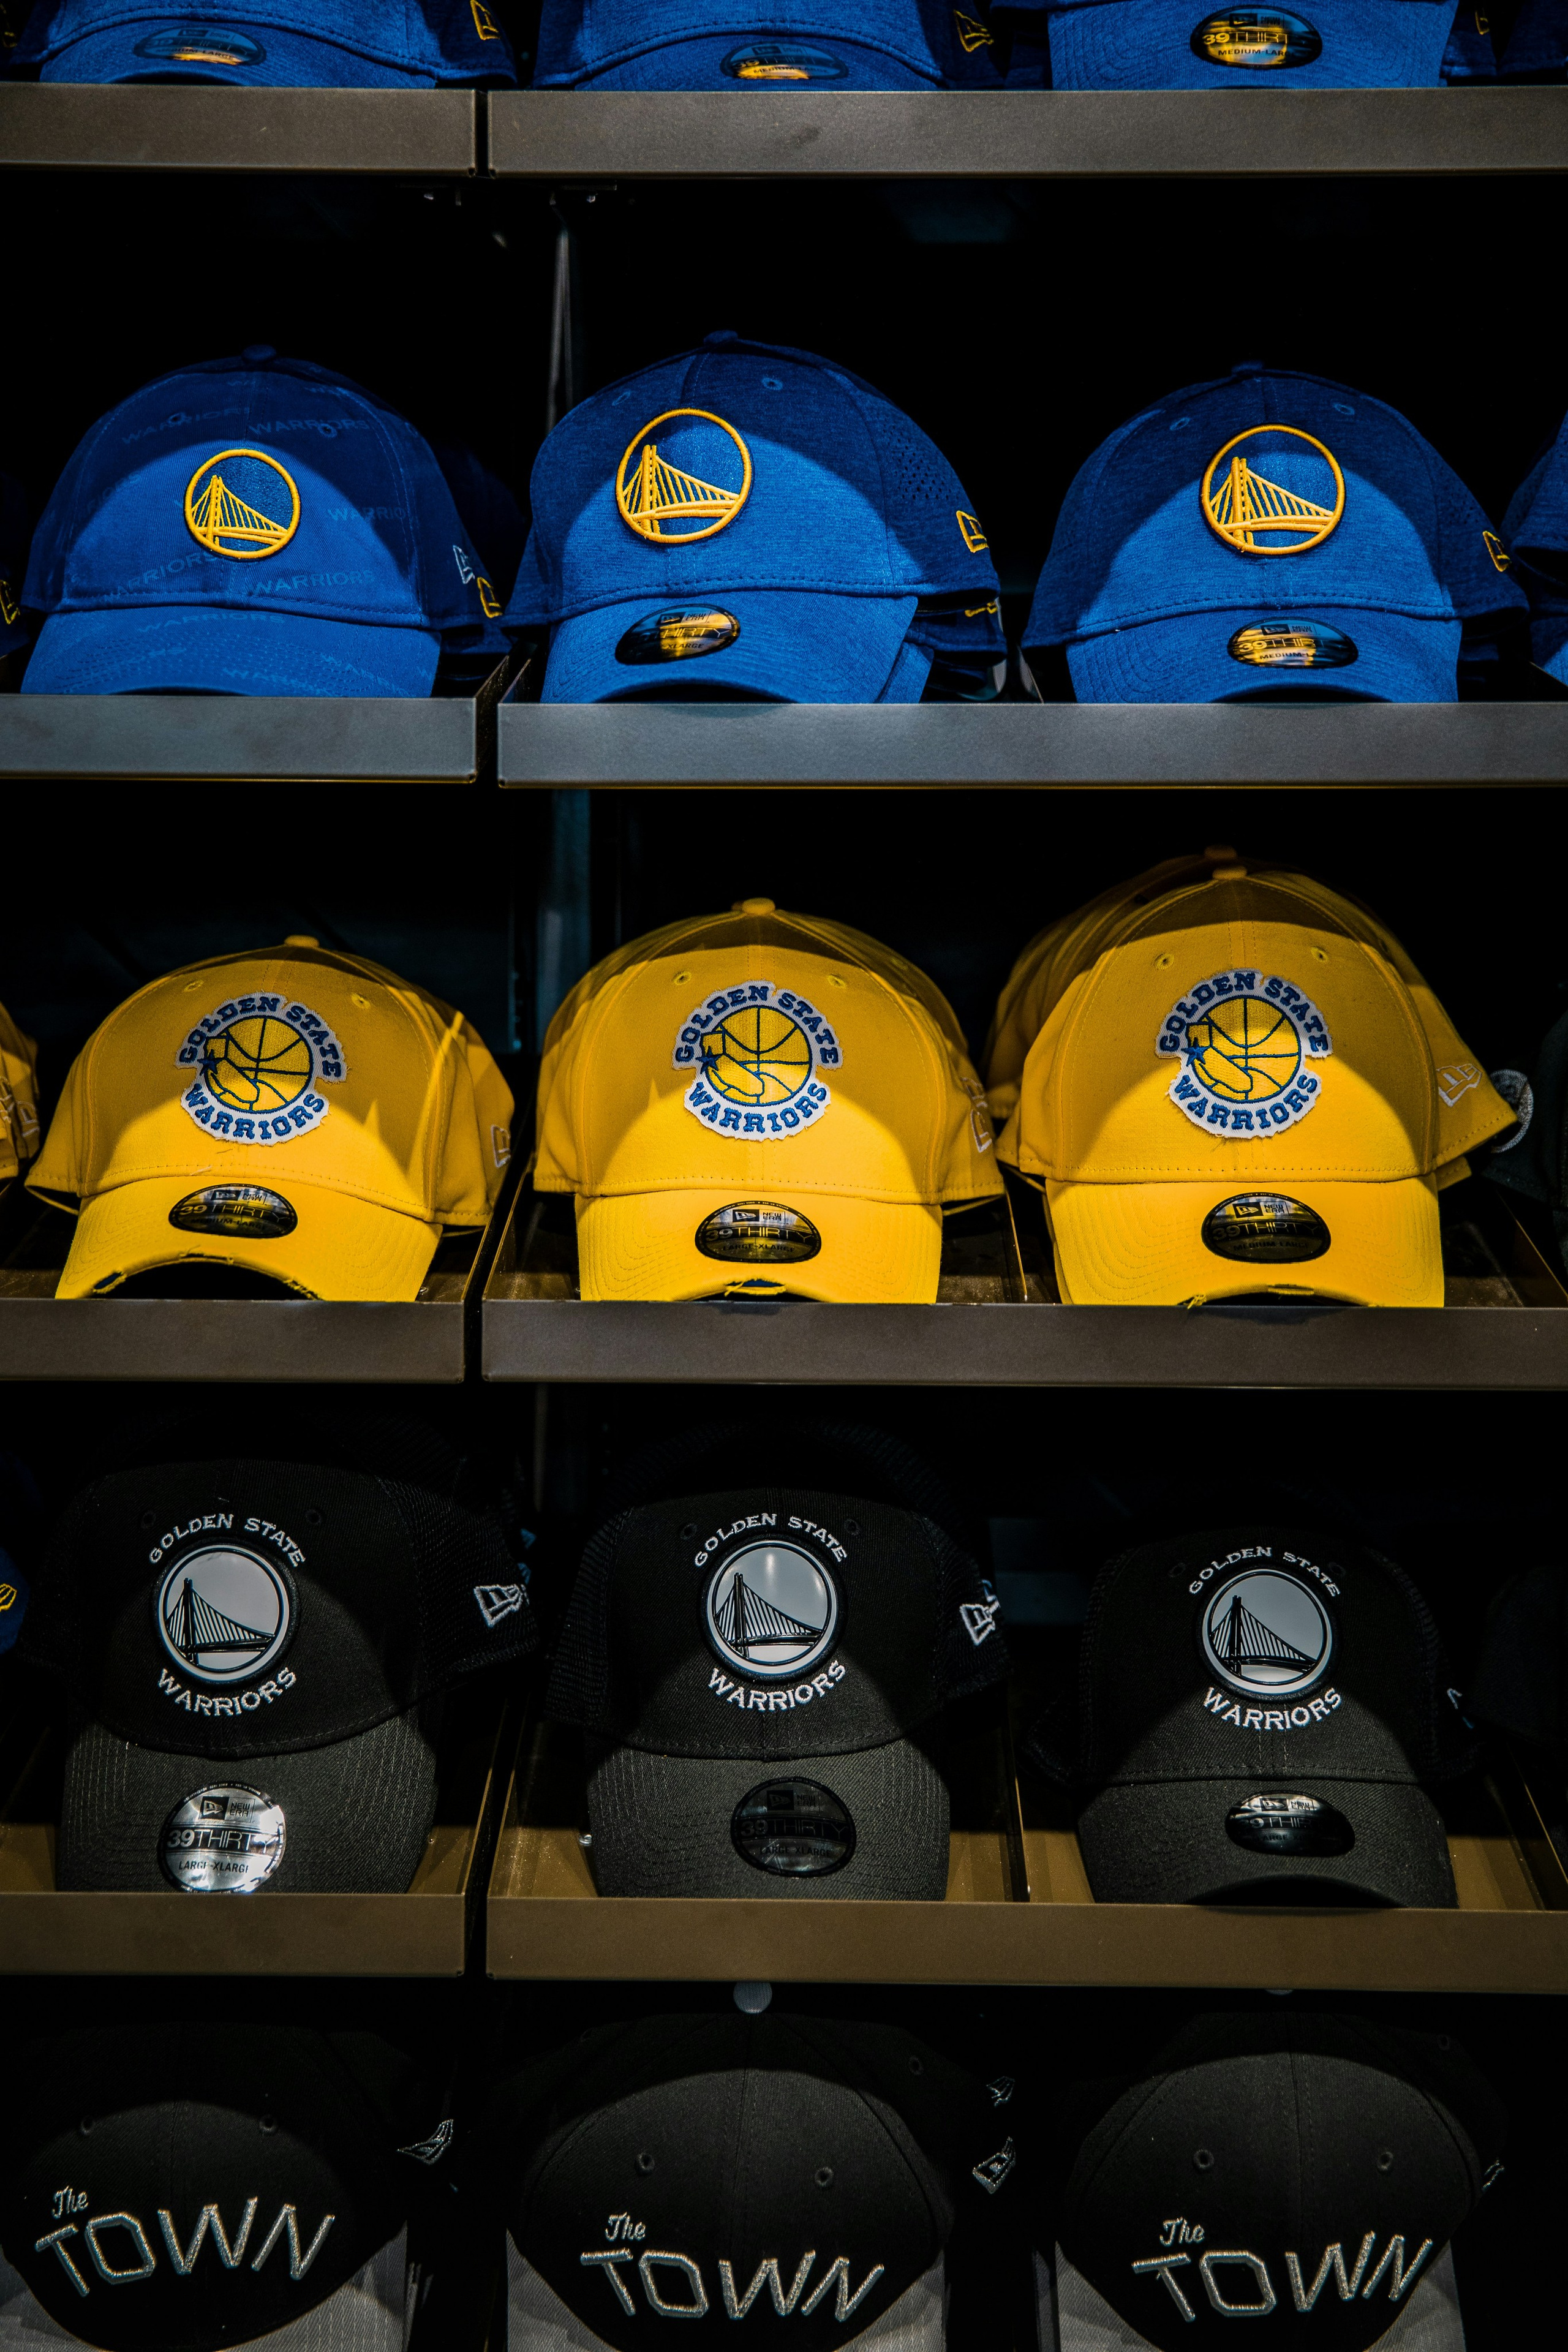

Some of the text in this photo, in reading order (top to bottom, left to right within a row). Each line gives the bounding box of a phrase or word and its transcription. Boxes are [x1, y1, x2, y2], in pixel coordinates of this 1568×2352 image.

[1202, 32, 1288, 45] 39THIRT
[179, 997, 342, 1077] GOLDEN STATE
[676, 986, 839, 1064] GOLDEN STATE
[1159, 973, 1329, 1052] GOLDEN STATE
[186, 1084, 324, 1139] WARRIORS
[689, 1082, 827, 1133] WARRIORS
[1174, 1075, 1317, 1131] WARRIORS
[179, 1204, 291, 1223] 39THIRTY
[705, 1226, 813, 1243] 39THIRTY
[1212, 1221, 1318, 1241] 39THIRTY
[149, 1513, 306, 1567] GOLDEN STATE
[694, 1513, 848, 1567] GOLDEN STATE
[1188, 1546, 1341, 1597] GOLDEN STATE
[157, 1667, 297, 1716] WARRIORS
[708, 1660, 846, 1711] WARRIORS
[1203, 1687, 1343, 1731] WARRIORS
[167, 1828, 279, 1855] 39THIRTY
[740, 1818, 850, 1840] 39THIRTY
[51, 2184, 89, 2220] The
[603, 2211, 647, 2244] The
[34, 2196, 336, 2299] TOWN
[1158, 2216, 1207, 2248] The
[579, 2249, 886, 2323] TOWN
[1131, 2230, 1434, 2324] TOWN
